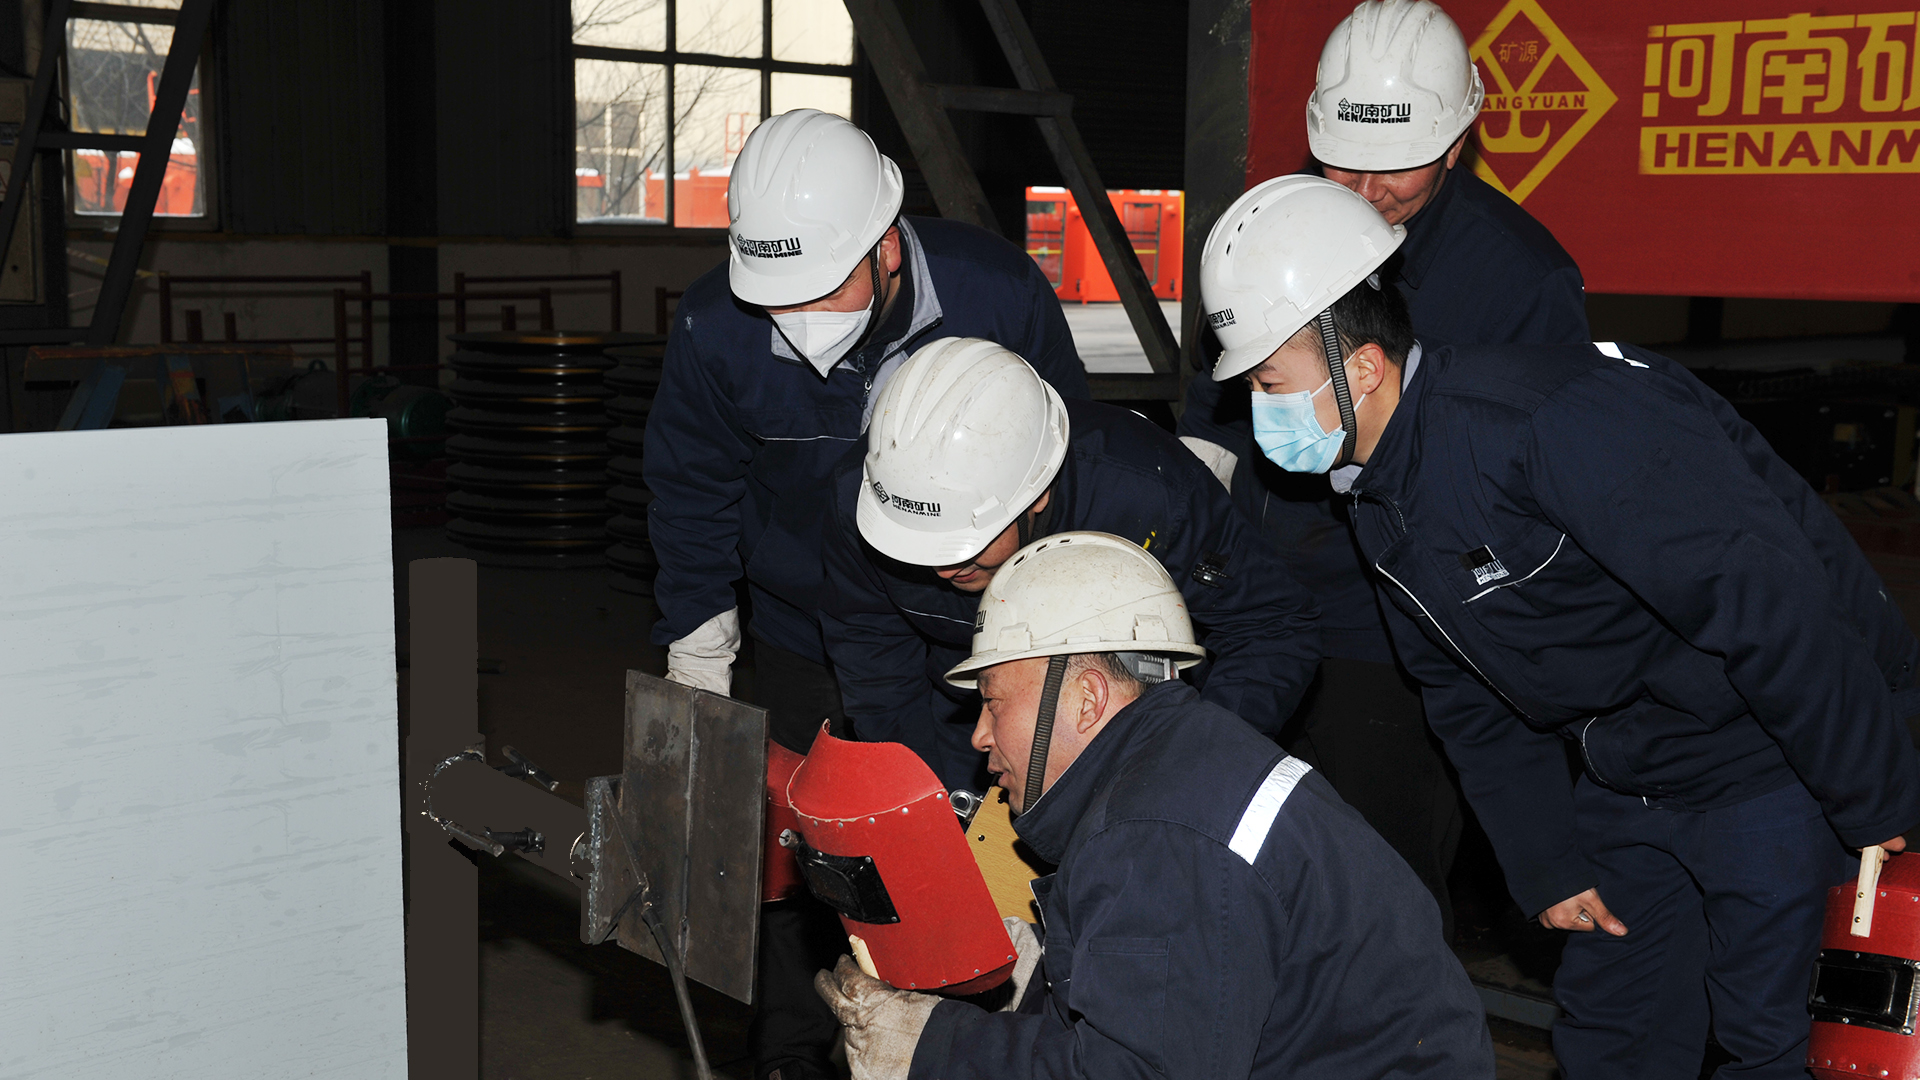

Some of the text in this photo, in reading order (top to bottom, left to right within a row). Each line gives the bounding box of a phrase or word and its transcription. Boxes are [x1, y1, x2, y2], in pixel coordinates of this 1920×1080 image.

[1499, 40, 1539, 63] 矿源
[1351, 103, 1411, 119] 河南矿山
[746, 237, 801, 254] 河南矿山
